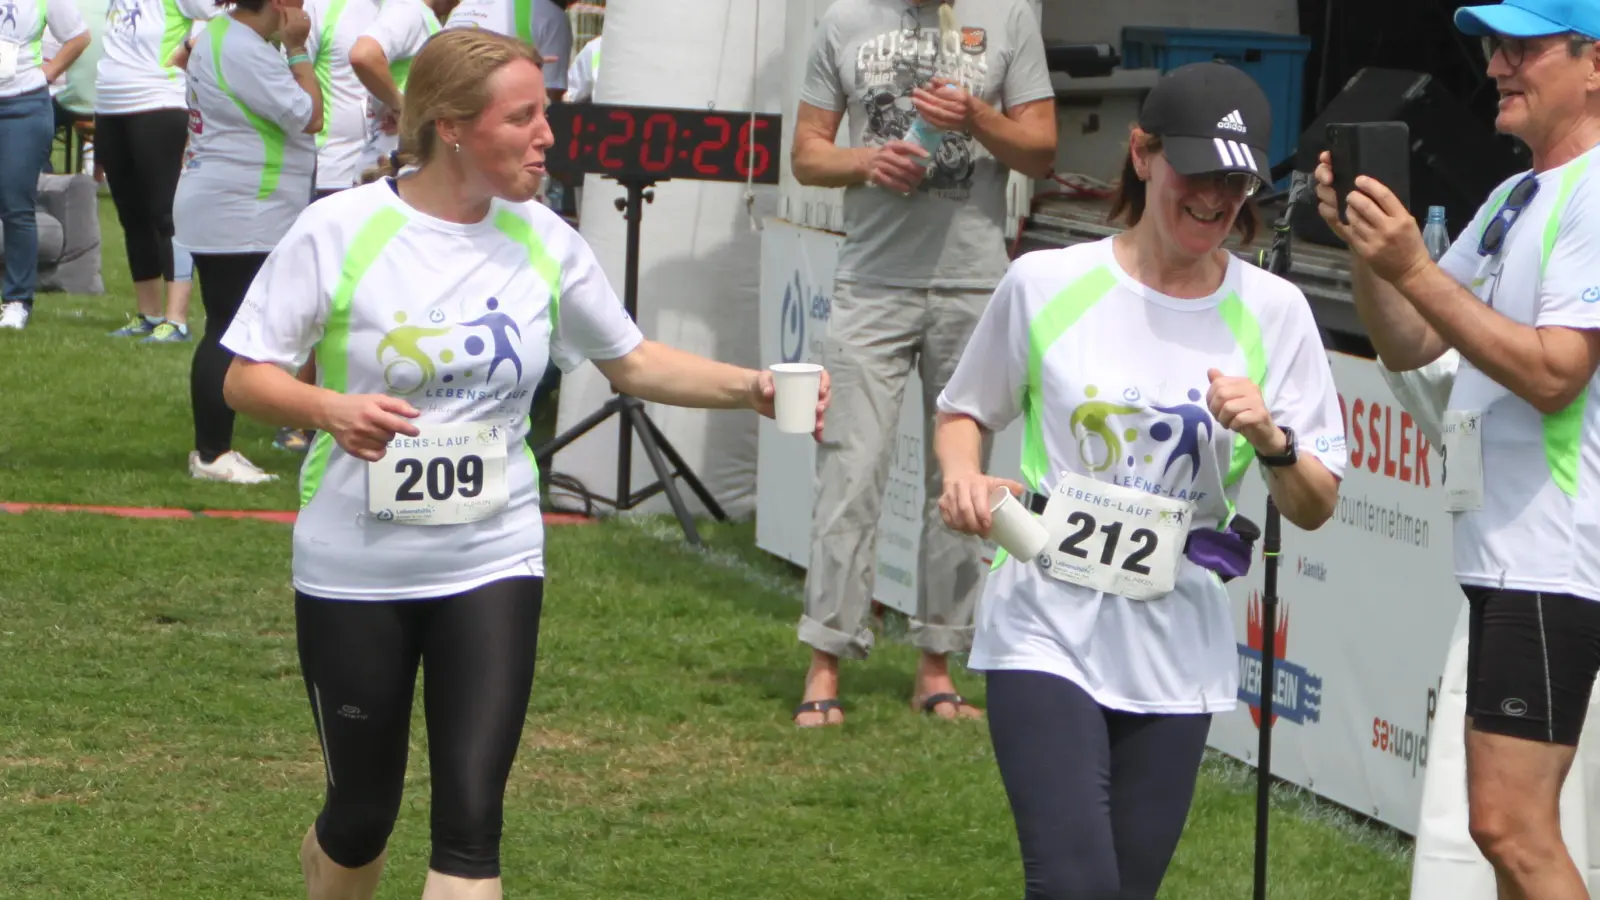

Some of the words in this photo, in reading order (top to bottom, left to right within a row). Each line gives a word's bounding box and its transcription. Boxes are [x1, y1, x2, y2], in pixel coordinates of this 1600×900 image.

[568, 110, 770, 177] 1:20:26
[1216, 121, 1247, 133] adidas
[386, 435, 471, 449] EBENS-LAUF
[394, 454, 484, 502] 209
[1059, 485, 1153, 518] LEBENS-LAUF
[1058, 511, 1158, 576] 212
[1334, 493, 1430, 549] rounternehmen
